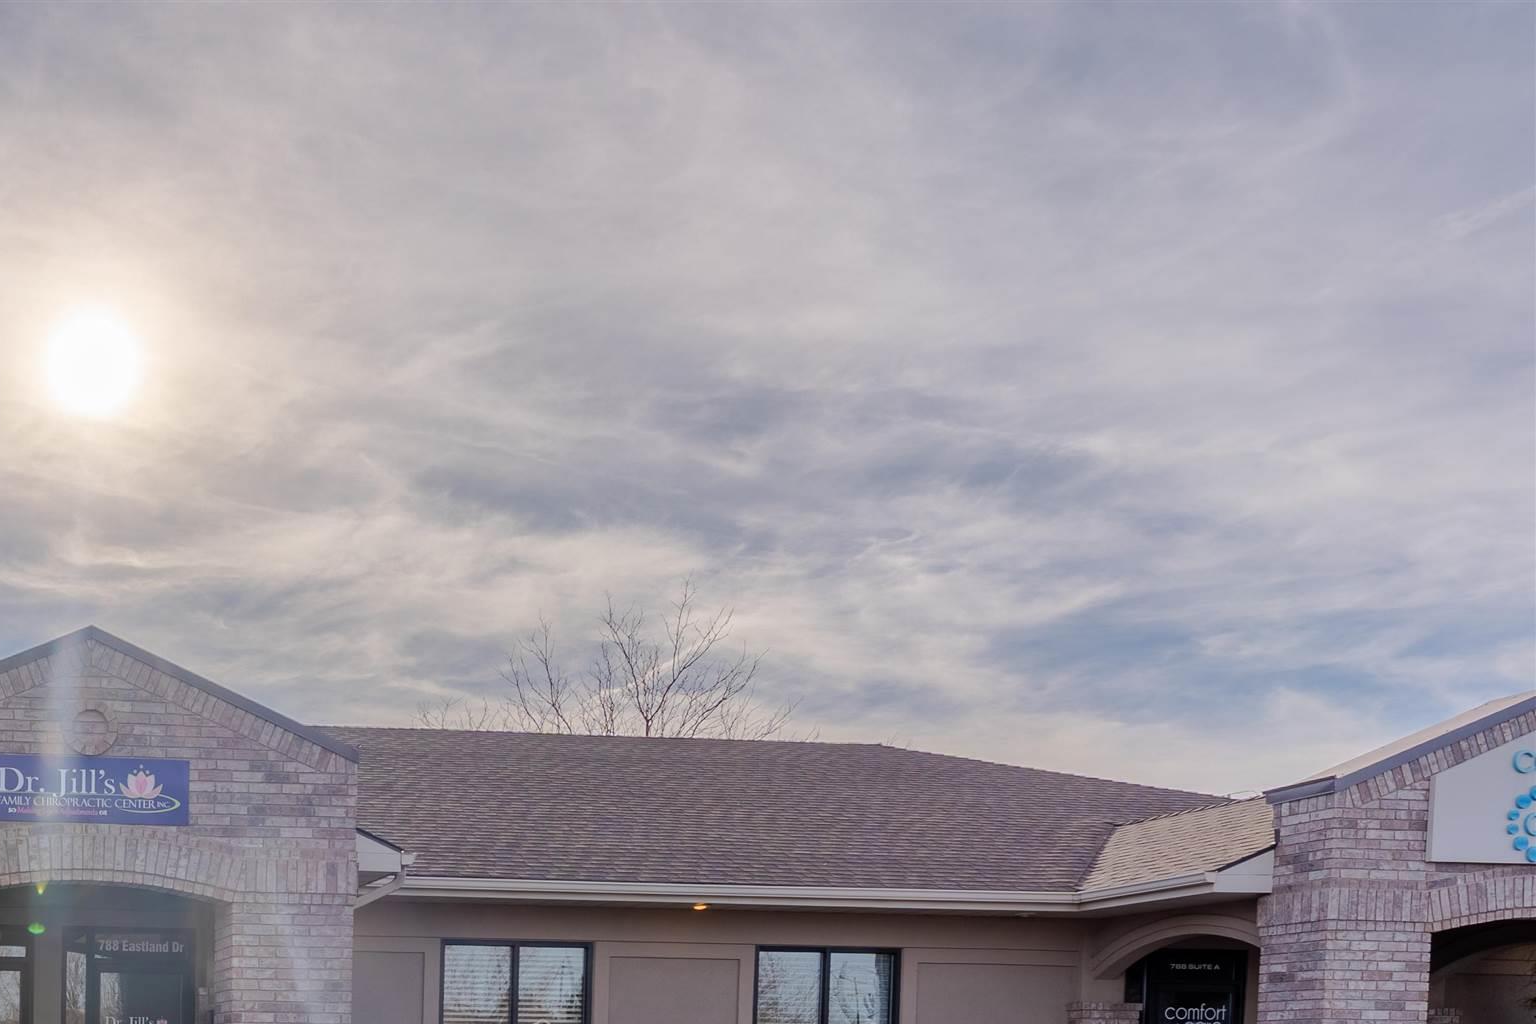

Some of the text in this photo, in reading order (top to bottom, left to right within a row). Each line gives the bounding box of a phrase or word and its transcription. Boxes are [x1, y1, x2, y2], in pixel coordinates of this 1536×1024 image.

[52, 768, 116, 797] Jill's
[33, 796, 113, 809] CHIROPRACTIC
[114, 799, 156, 809] CENTER
[98, 939, 184, 953] 788 Eastland Dr
[1165, 1003, 1227, 1020] comfort
